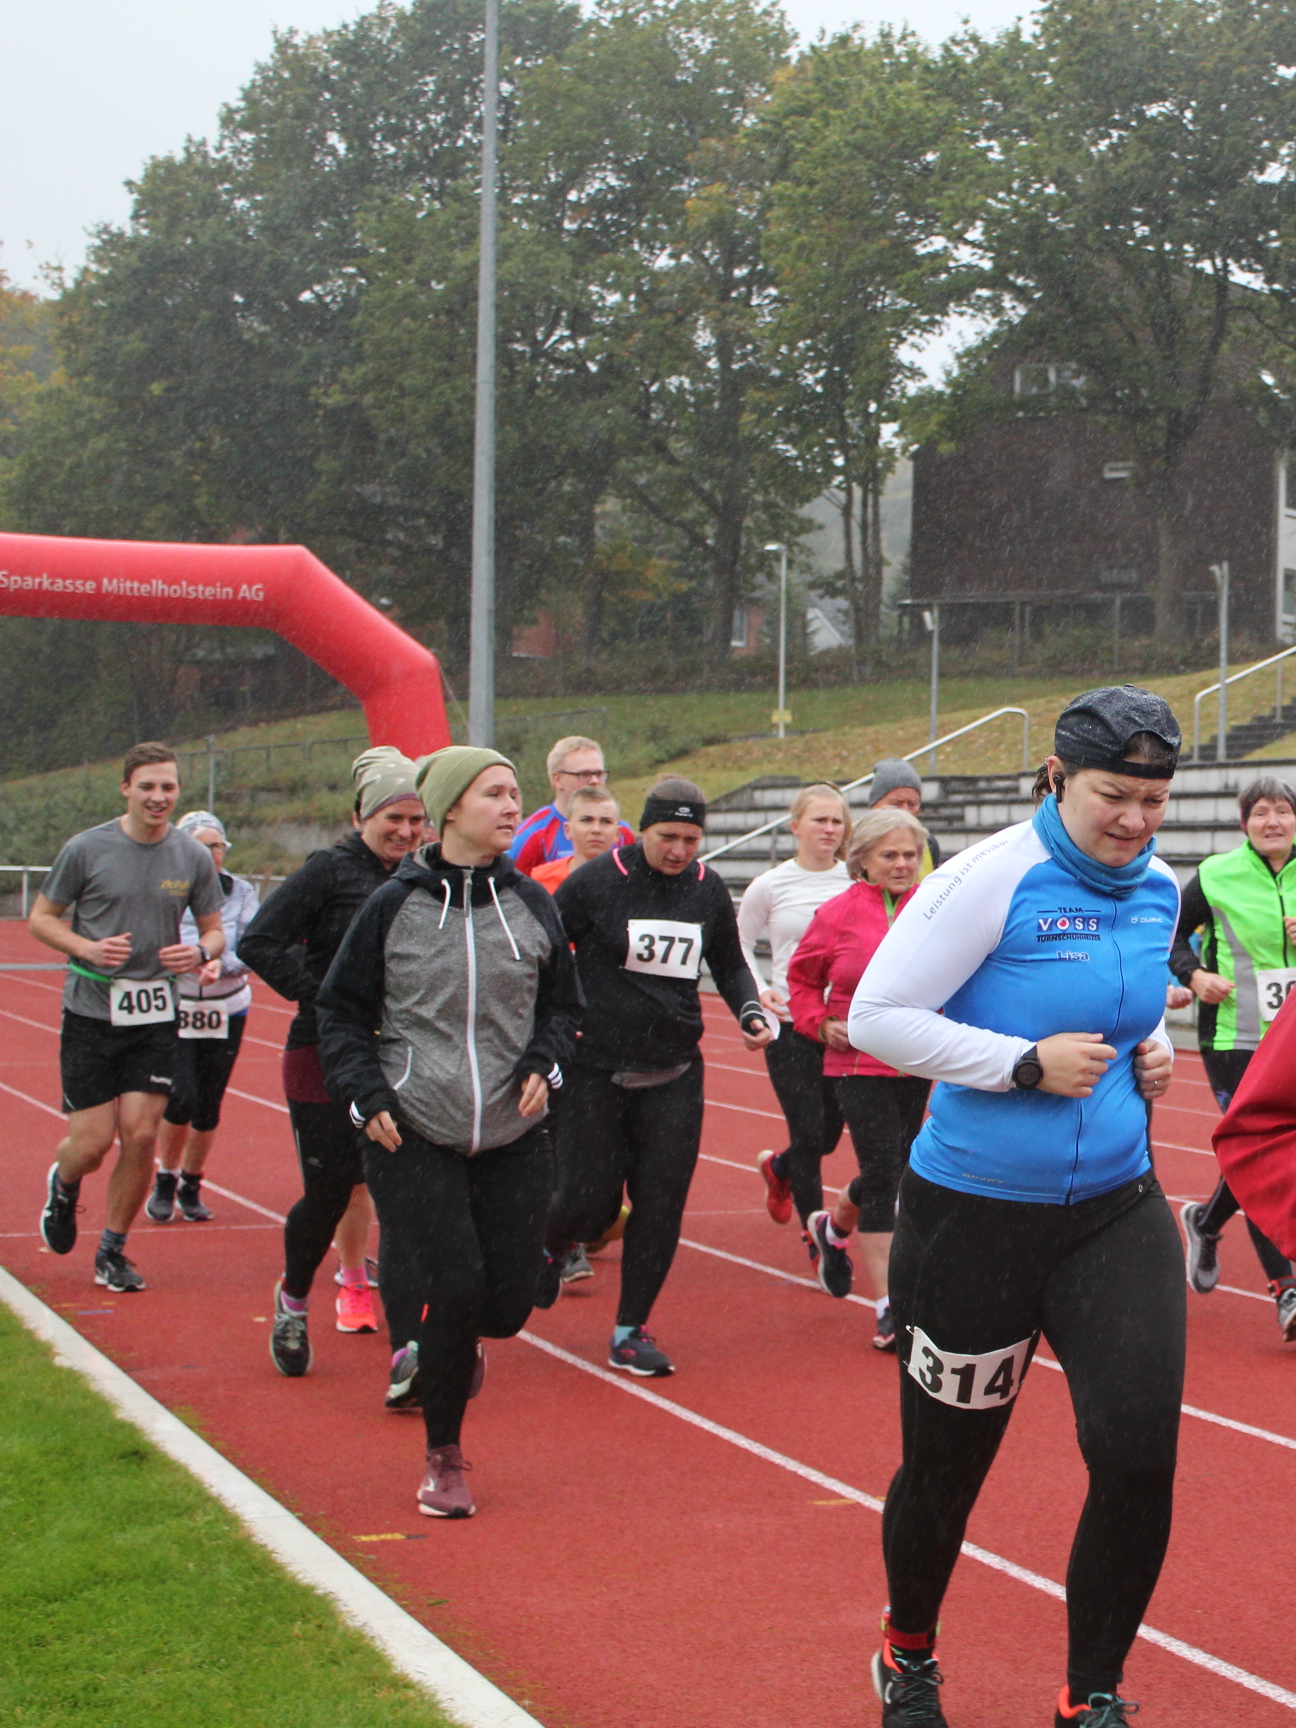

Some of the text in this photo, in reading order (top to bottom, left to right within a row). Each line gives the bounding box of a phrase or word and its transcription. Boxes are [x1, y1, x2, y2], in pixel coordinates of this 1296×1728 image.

[0, 570, 265, 601] Sparkasse Mittelholstein AG
[923, 839, 1013, 920] Leistung ist messbar.
[1037, 916, 1099, 932] VOSS
[635, 933, 695, 967] 377
[1056, 950, 1090, 962] Lisa
[117, 987, 168, 1016] 405
[918, 1346, 1016, 1404] 314
